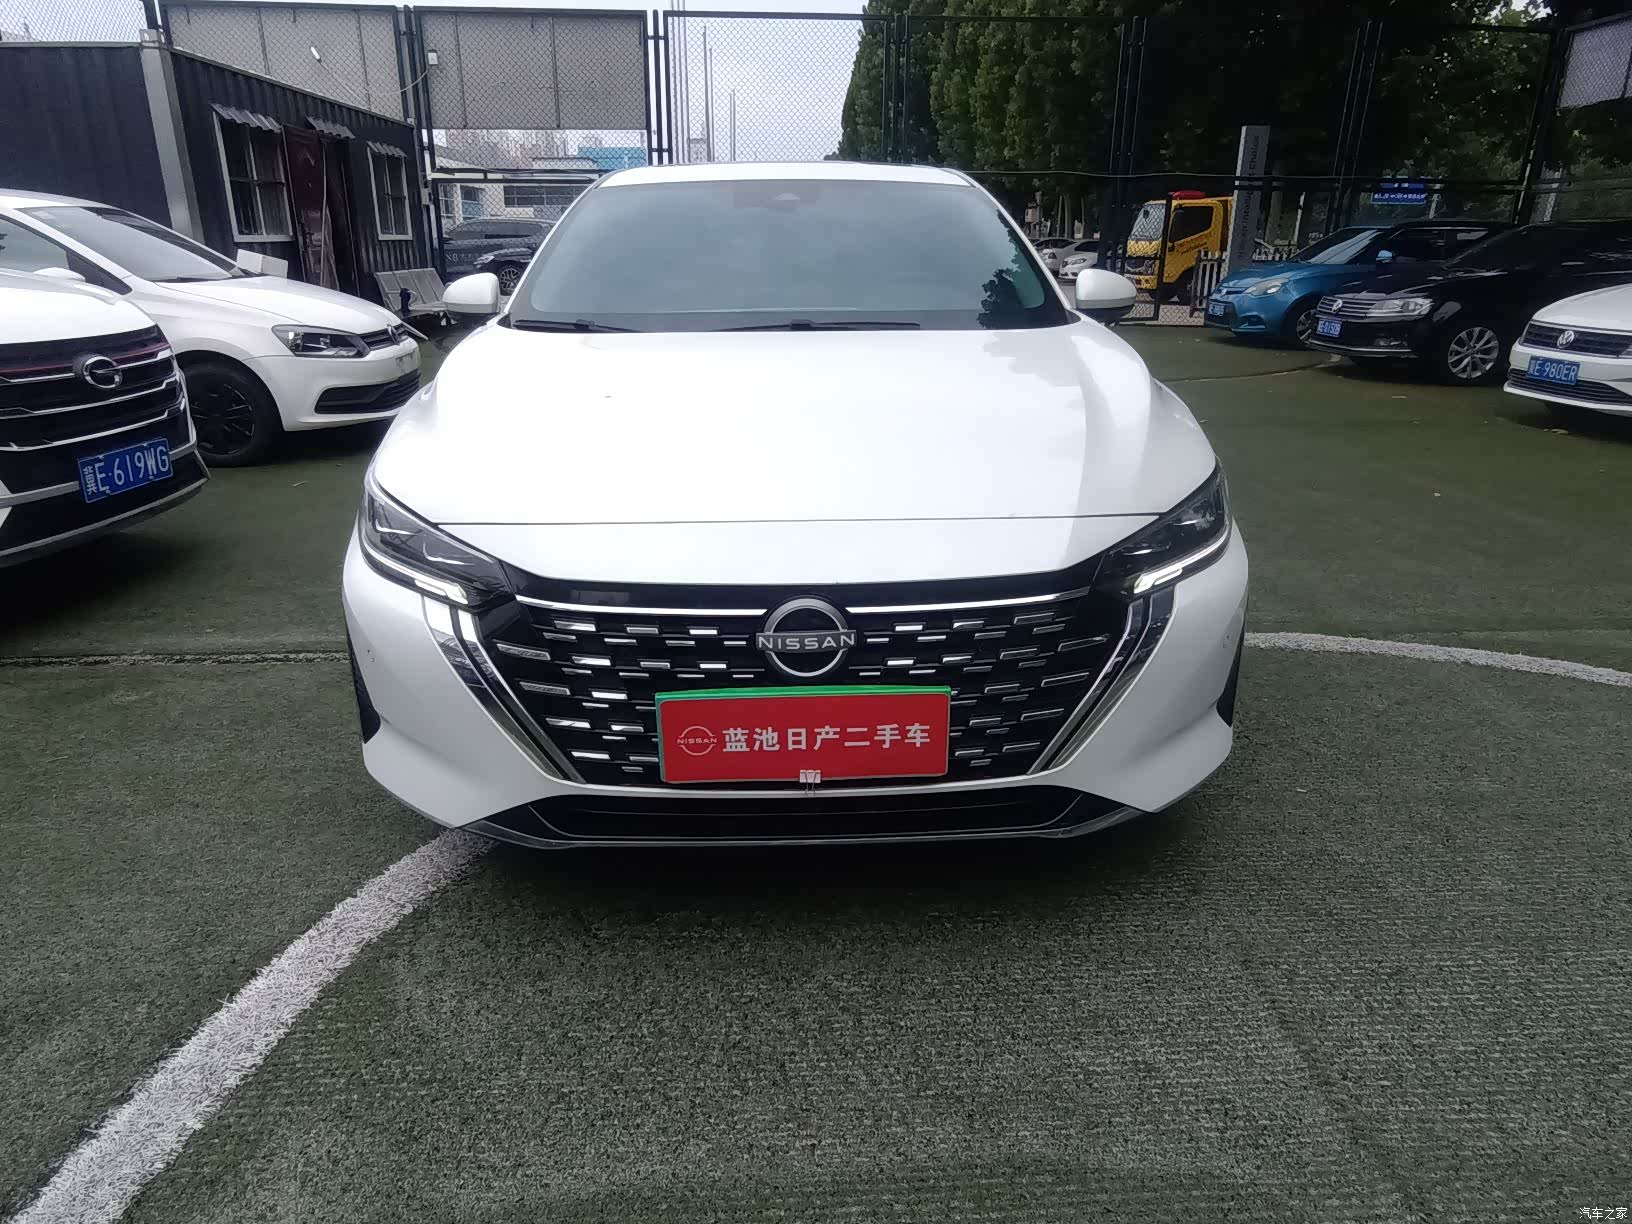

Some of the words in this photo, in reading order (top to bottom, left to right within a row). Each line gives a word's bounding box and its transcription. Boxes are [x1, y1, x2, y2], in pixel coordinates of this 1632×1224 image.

[758, 633, 855, 650] NISSAN
[676, 737, 718, 745] NISSAN
[722, 723, 930, 752] 蓝池日产二手车
